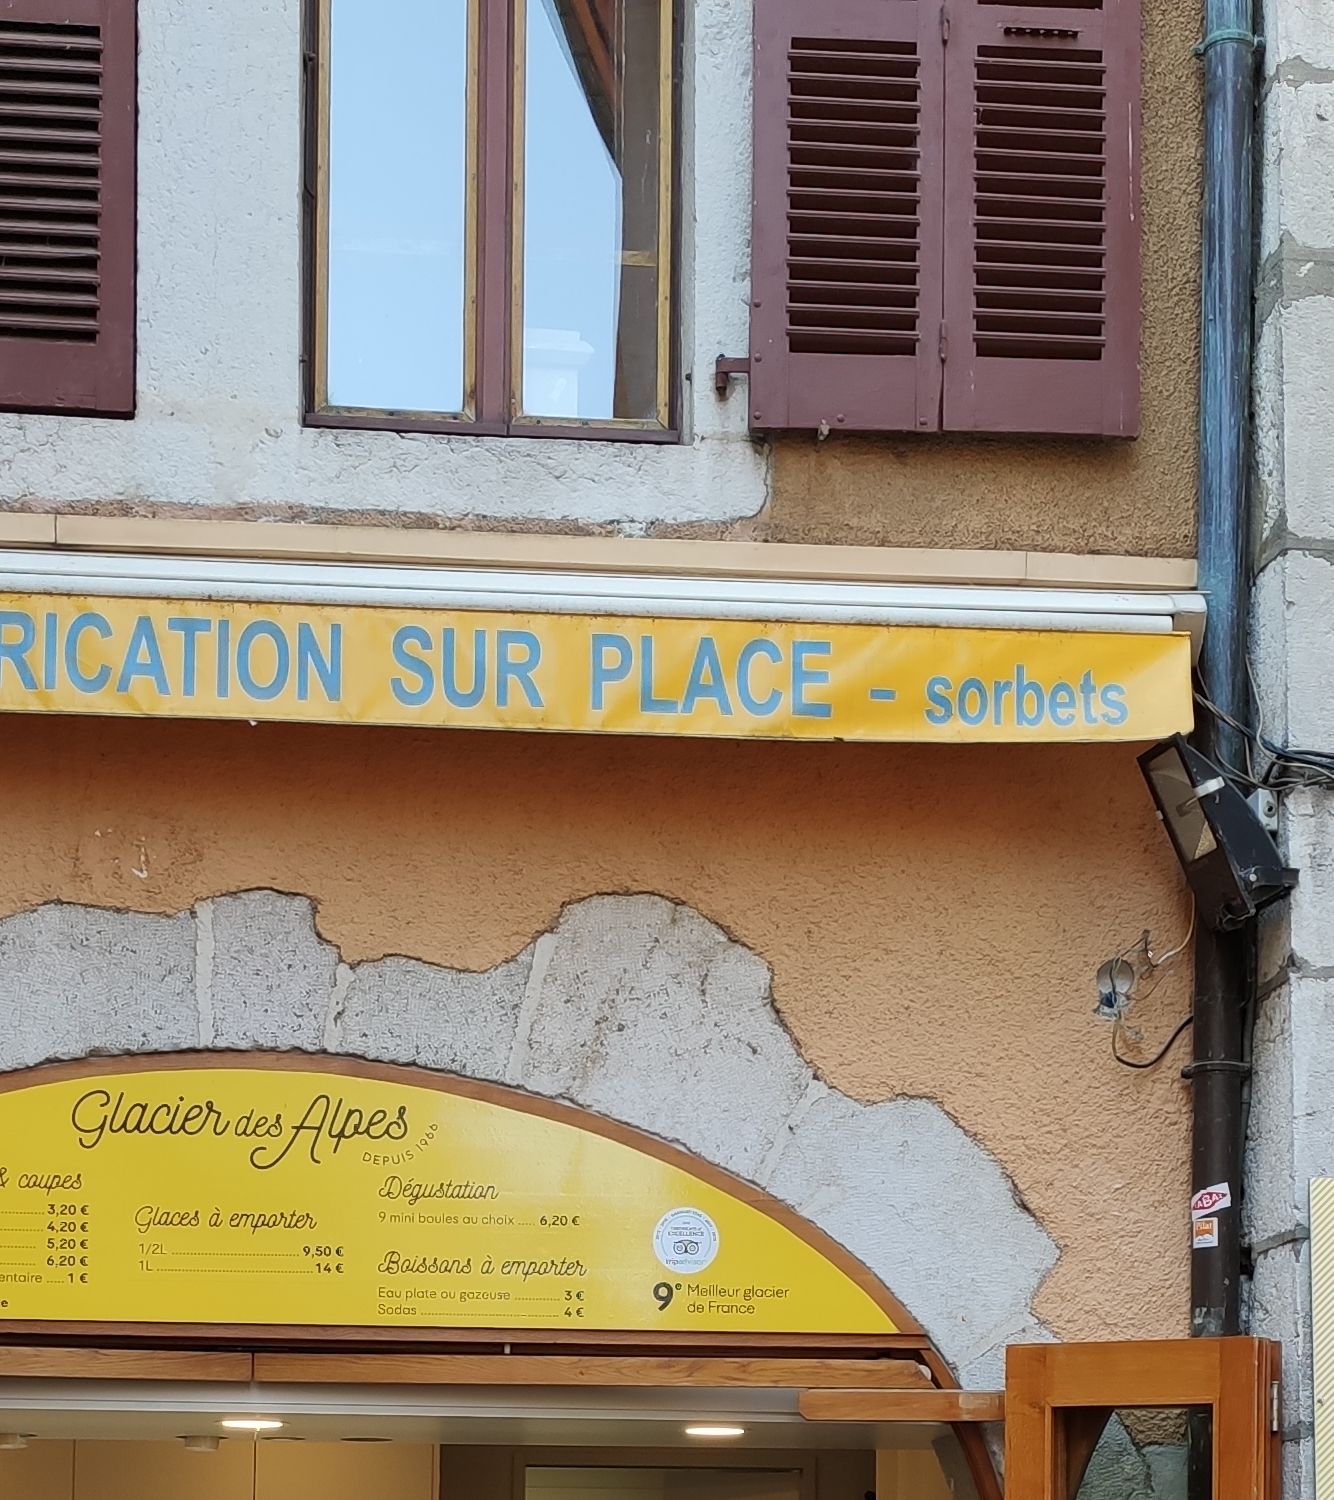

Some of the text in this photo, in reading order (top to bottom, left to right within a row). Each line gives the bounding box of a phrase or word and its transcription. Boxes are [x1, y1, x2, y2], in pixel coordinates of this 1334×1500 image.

[389, 624, 545, 709] SUR
[589, 632, 833, 719] PLACE
[924, 663, 1130, 728] sorbets
[71, 1089, 439, 1170] Glacier des Alpes DEPUIS 1966
[17, 1173, 83, 1196] coupes
[378, 1175, 500, 1206] Dégustation
[46, 1203, 77, 1217] 3,20
[79, 1204, 90, 1216] €
[46, 1220, 77, 1234] 4,20
[79, 1221, 90, 1233] €
[134, 1205, 318, 1235] Glaces à emporter
[378, 1211, 581, 1228] 9 mini boules au choix 6,20 €
[46, 1237, 77, 1251] 5,20
[79, 1238, 90, 1250] €
[302, 1244, 334, 1259] 9,50
[335, 1244, 345, 1258] €
[46, 1254, 77, 1268] 6,20
[79, 1255, 90, 1267] €
[138, 1259, 345, 1274] 1L 14 €
[377, 1250, 588, 1283] Boissons à emporter
[67, 1272, 75, 1284] 1
[79, 1272, 89, 1284] €
[378, 1286, 585, 1303] Eau plate ou gazeuse 3 €
[687, 1283, 741, 1298] Meilleur
[743, 1284, 790, 1301] glacier
[377, 1303, 585, 1318] Sodas 4 €
[687, 1301, 756, 1315] de France
